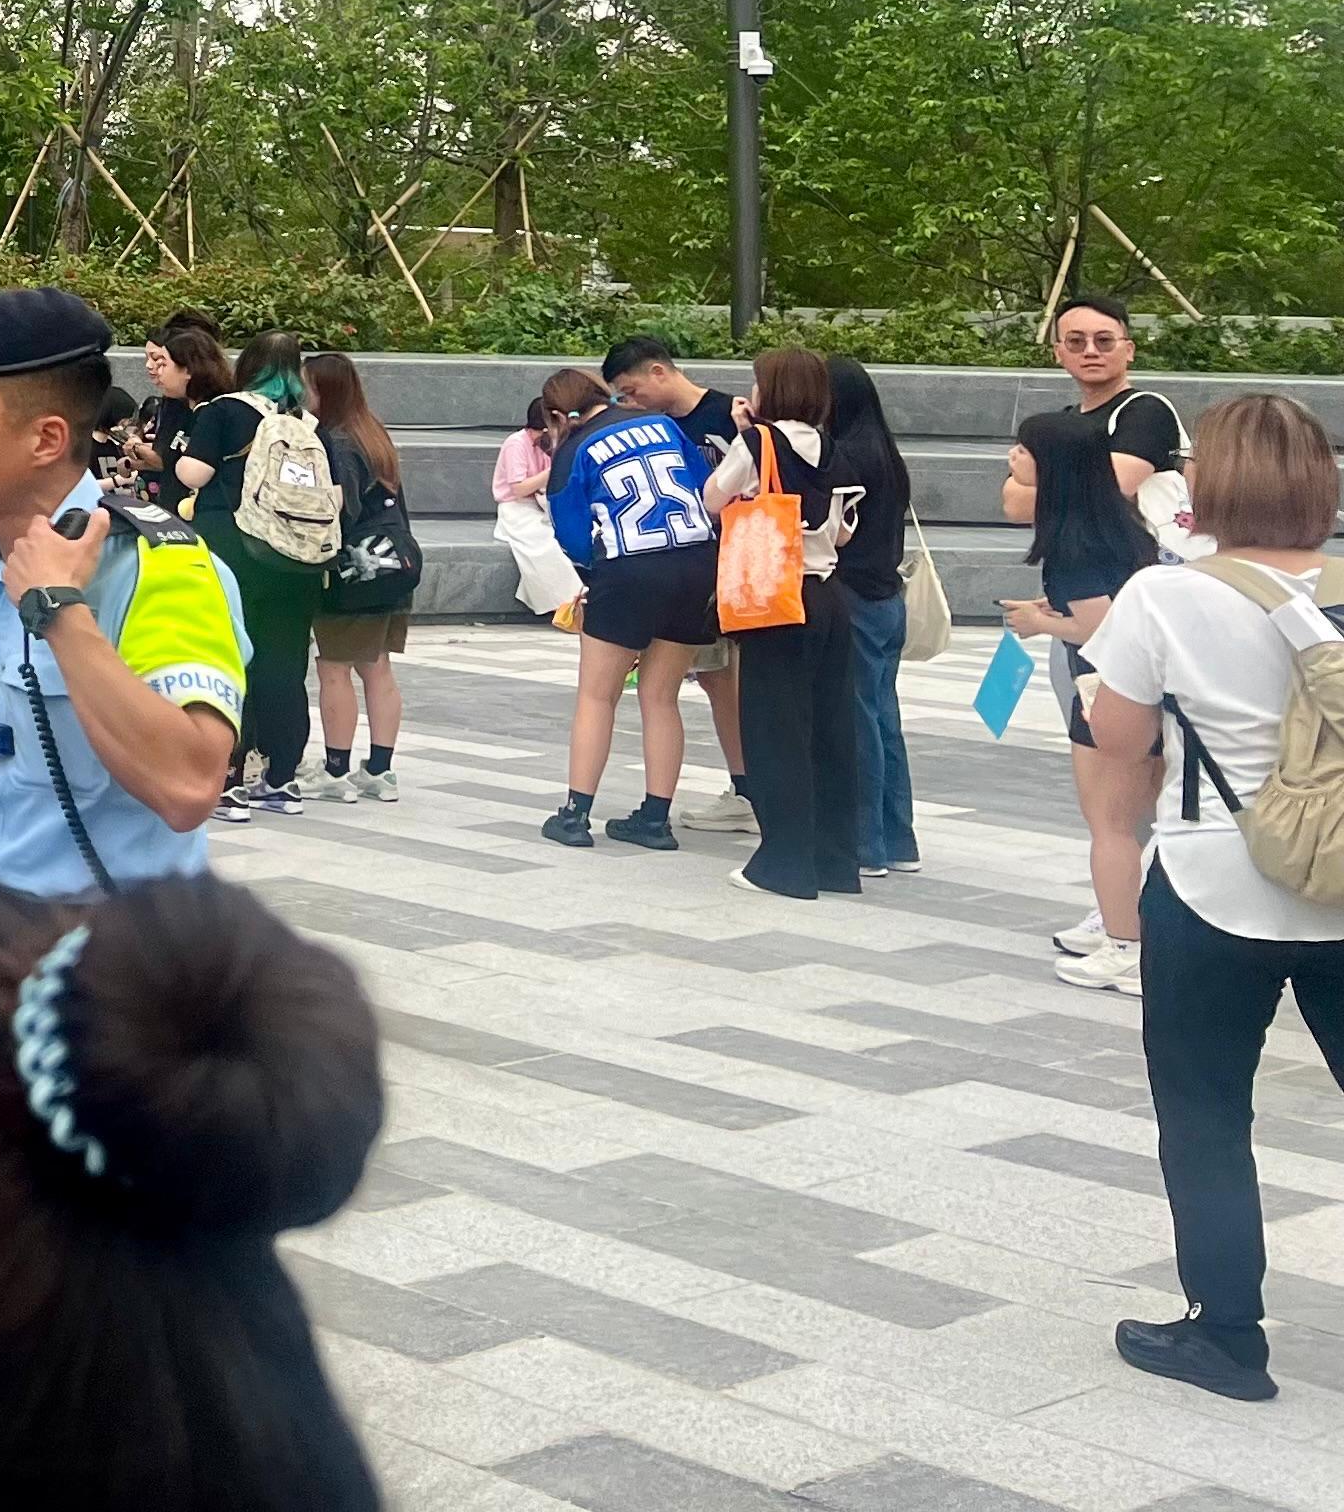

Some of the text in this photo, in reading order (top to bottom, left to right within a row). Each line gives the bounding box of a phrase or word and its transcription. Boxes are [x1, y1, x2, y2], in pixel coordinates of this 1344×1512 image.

[586, 423, 672, 465] MAYDAY
[600, 450, 710, 556] 25
[164, 672, 233, 706] POLICE
